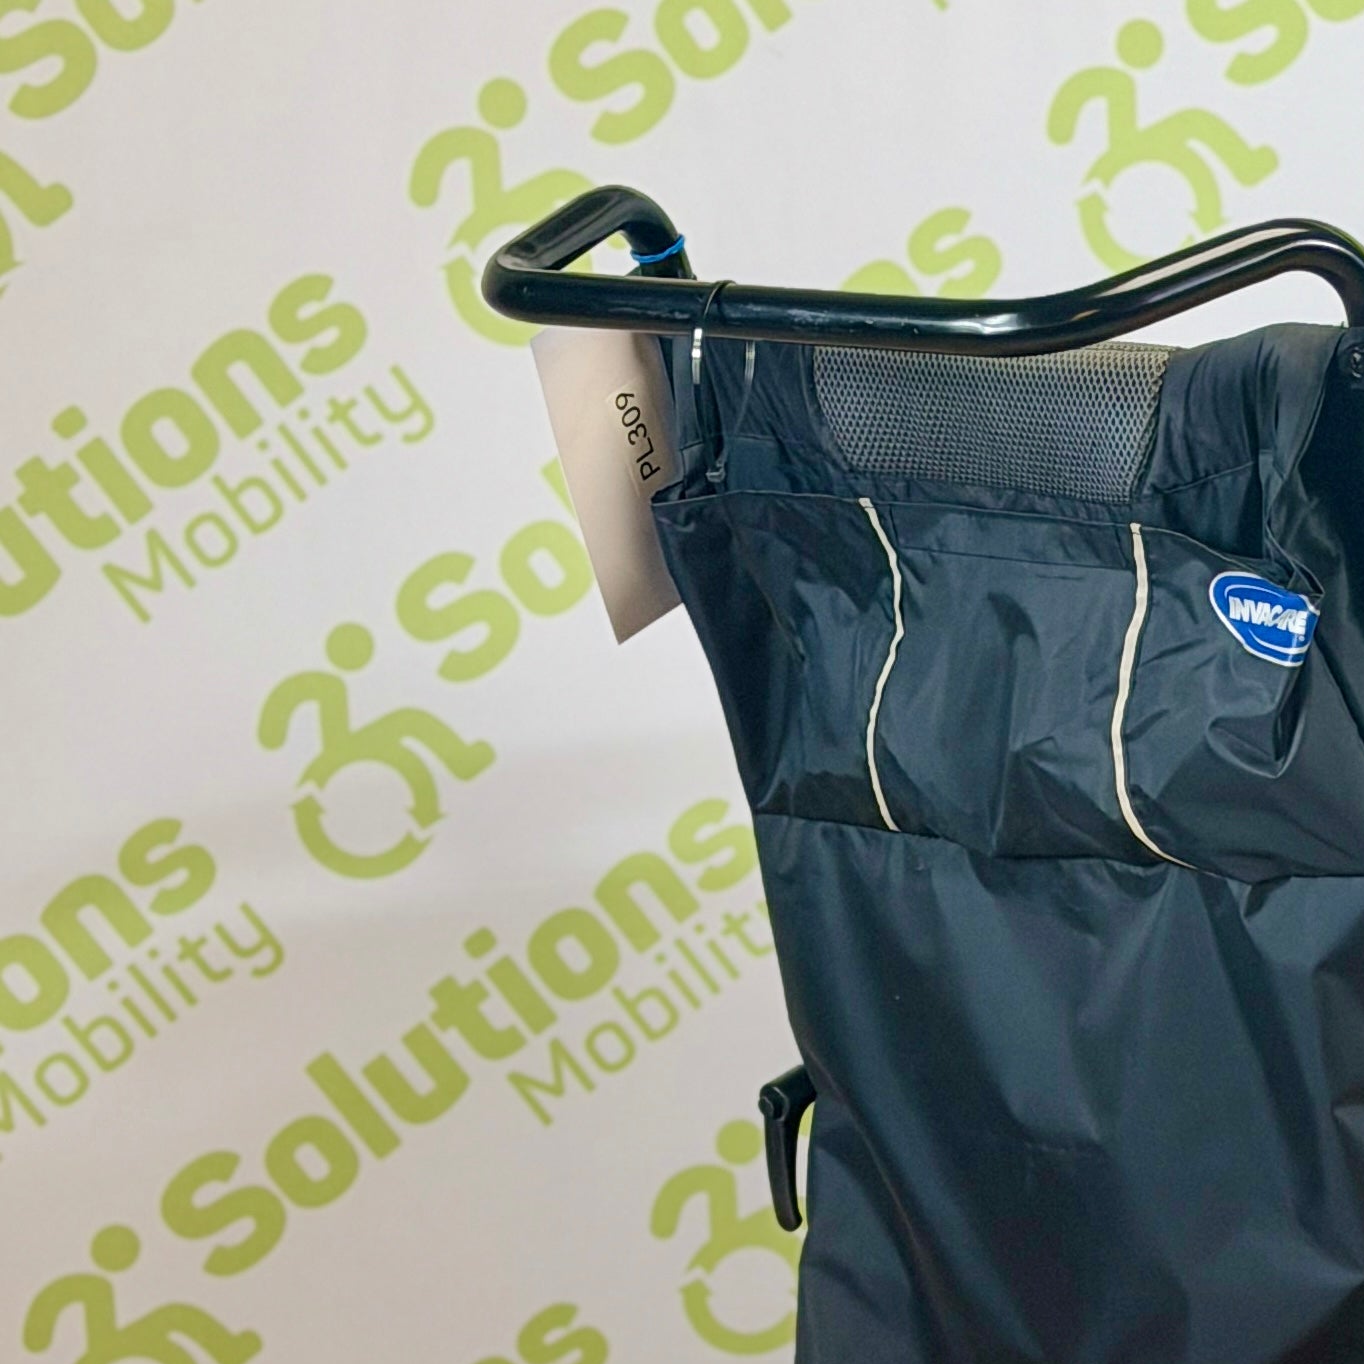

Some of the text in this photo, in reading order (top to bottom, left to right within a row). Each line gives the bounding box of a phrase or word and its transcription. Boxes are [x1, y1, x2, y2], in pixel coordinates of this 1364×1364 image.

[100, 362, 435, 624] Mobility
[615, 392, 661, 481] PL309
[158, 797, 761, 1280] Solutions
[505, 899, 777, 1128] Mobilit
